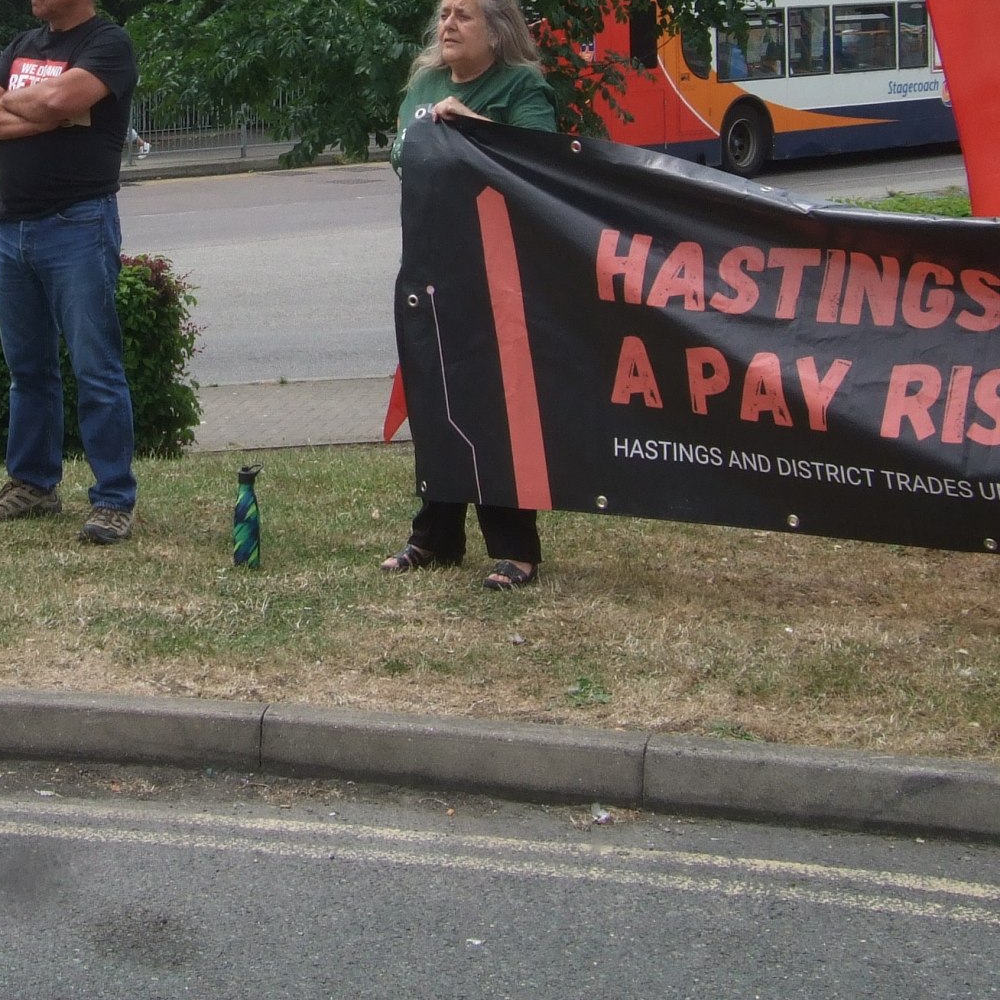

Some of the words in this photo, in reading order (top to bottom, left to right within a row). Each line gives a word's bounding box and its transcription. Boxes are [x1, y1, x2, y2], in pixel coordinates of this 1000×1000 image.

[21, 63, 37, 73] WE
[887, 79, 940, 97] Stagecoach
[596, 228, 1000, 332] HASTINGS
[611, 336, 663, 409] A
[685, 346, 853, 432] PAY
[614, 437, 724, 467] HASTINGS
[728, 450, 772, 473] AND
[777, 457, 875, 488] DISTRICT
[881, 470, 974, 499] TRADES
